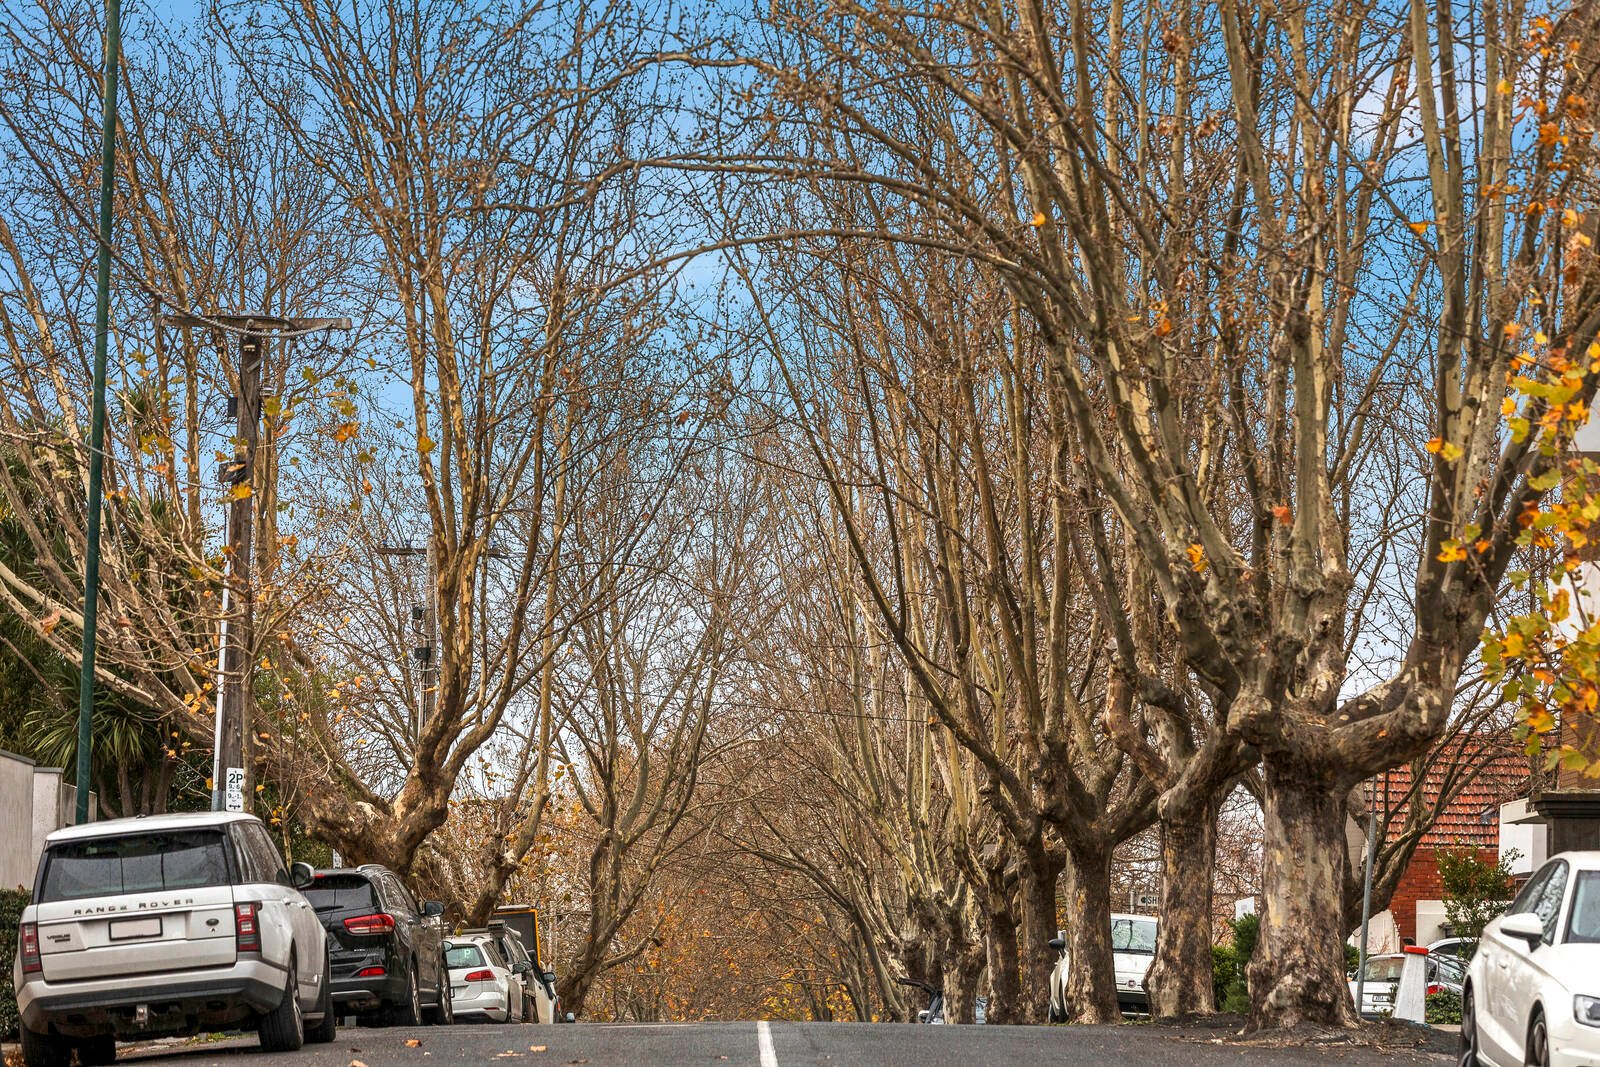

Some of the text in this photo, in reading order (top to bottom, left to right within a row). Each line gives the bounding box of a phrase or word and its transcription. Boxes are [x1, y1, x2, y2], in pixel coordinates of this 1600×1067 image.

[228, 773, 243, 784] 2P
[73, 898, 194, 915] RANGE ROVER
